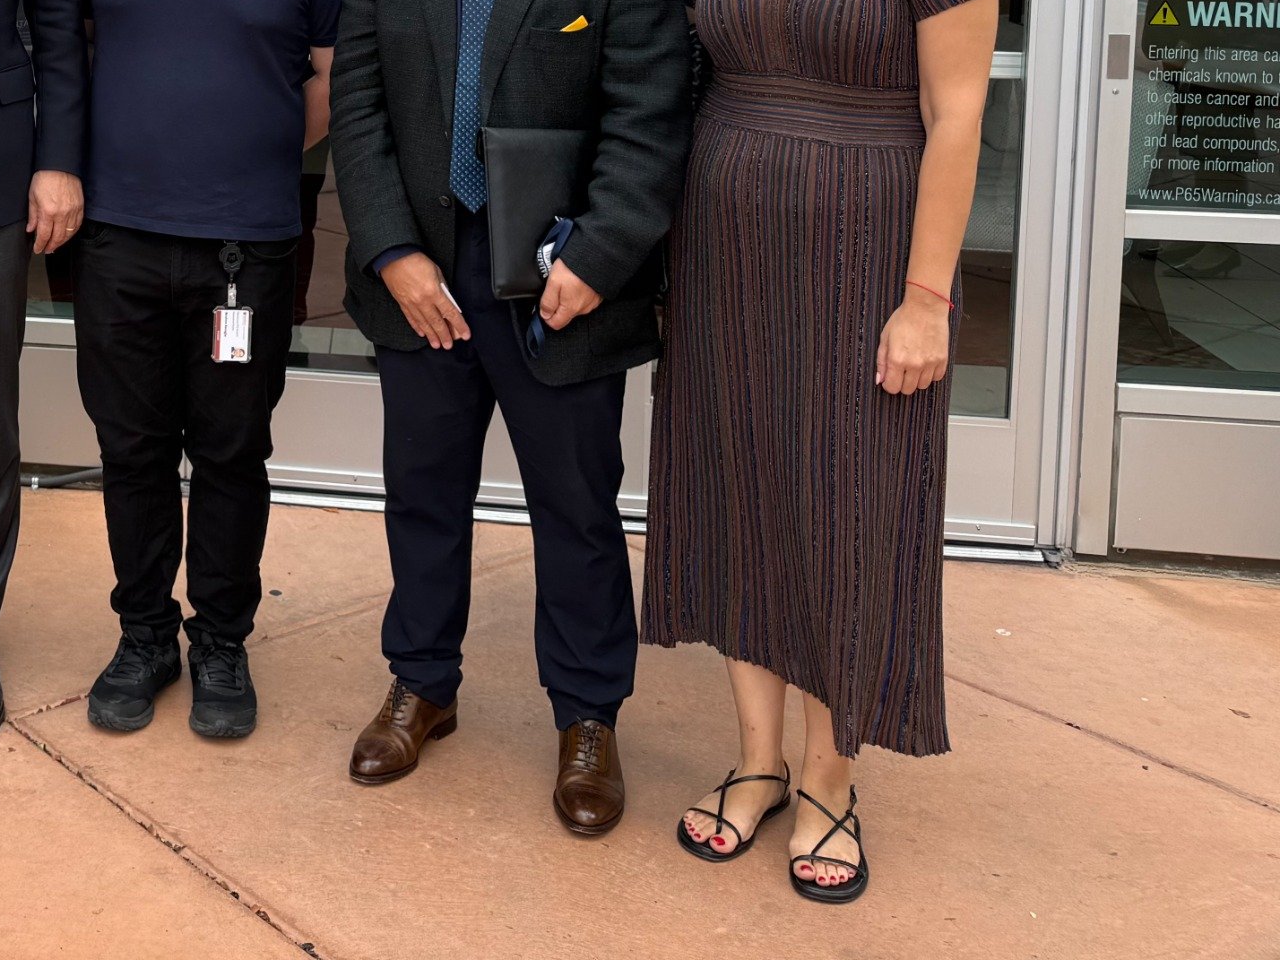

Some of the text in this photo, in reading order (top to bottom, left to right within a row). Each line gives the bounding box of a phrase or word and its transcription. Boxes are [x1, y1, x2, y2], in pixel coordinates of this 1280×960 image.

[1148, 44, 1199, 63] Entering
[1204, 46, 1227, 61] this
[1231, 49, 1259, 62] area
[1148, 67, 1211, 83] chemicals
[1215, 68, 1257, 84] known
[1262, 71, 1274, 84] to
[1147, 89, 1280, 107] to cause cancer and
[1145, 110, 1178, 126] other
[1181, 113, 1261, 130] reproductive
[1143, 133, 1280, 153] and lead compounds,
[1143, 154, 1275, 173] For more information
